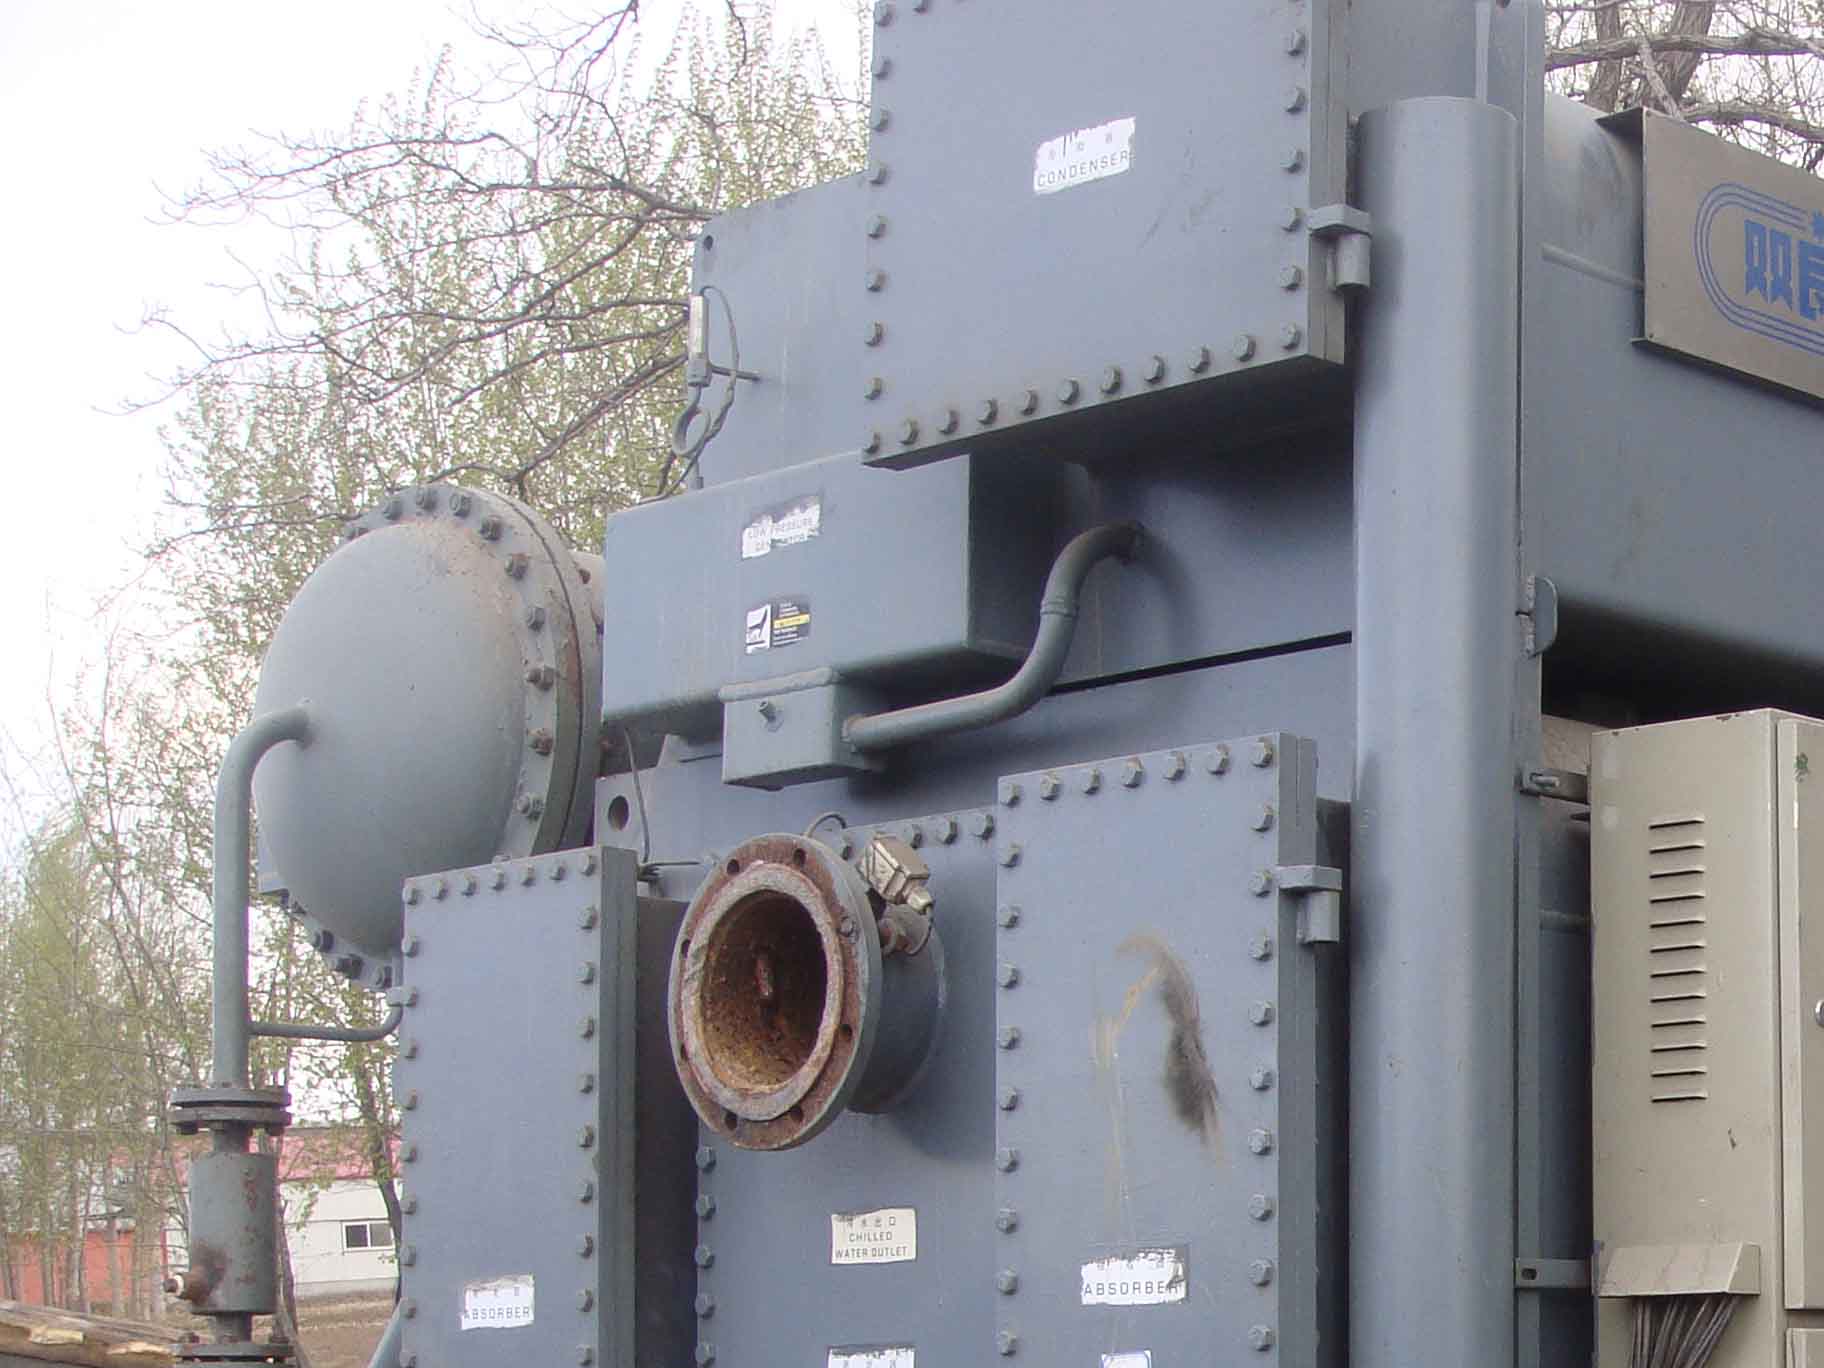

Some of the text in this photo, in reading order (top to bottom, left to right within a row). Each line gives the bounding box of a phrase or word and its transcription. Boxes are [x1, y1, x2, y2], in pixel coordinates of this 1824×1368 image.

[1037, 150, 1129, 187] CONDENSER
[848, 1231, 893, 1242] CHILLED
[835, 1246, 908, 1259] WATER OUTLET
[1084, 1281, 1178, 1295] ABSORBER
[464, 1305, 530, 1320] ABSORBER
